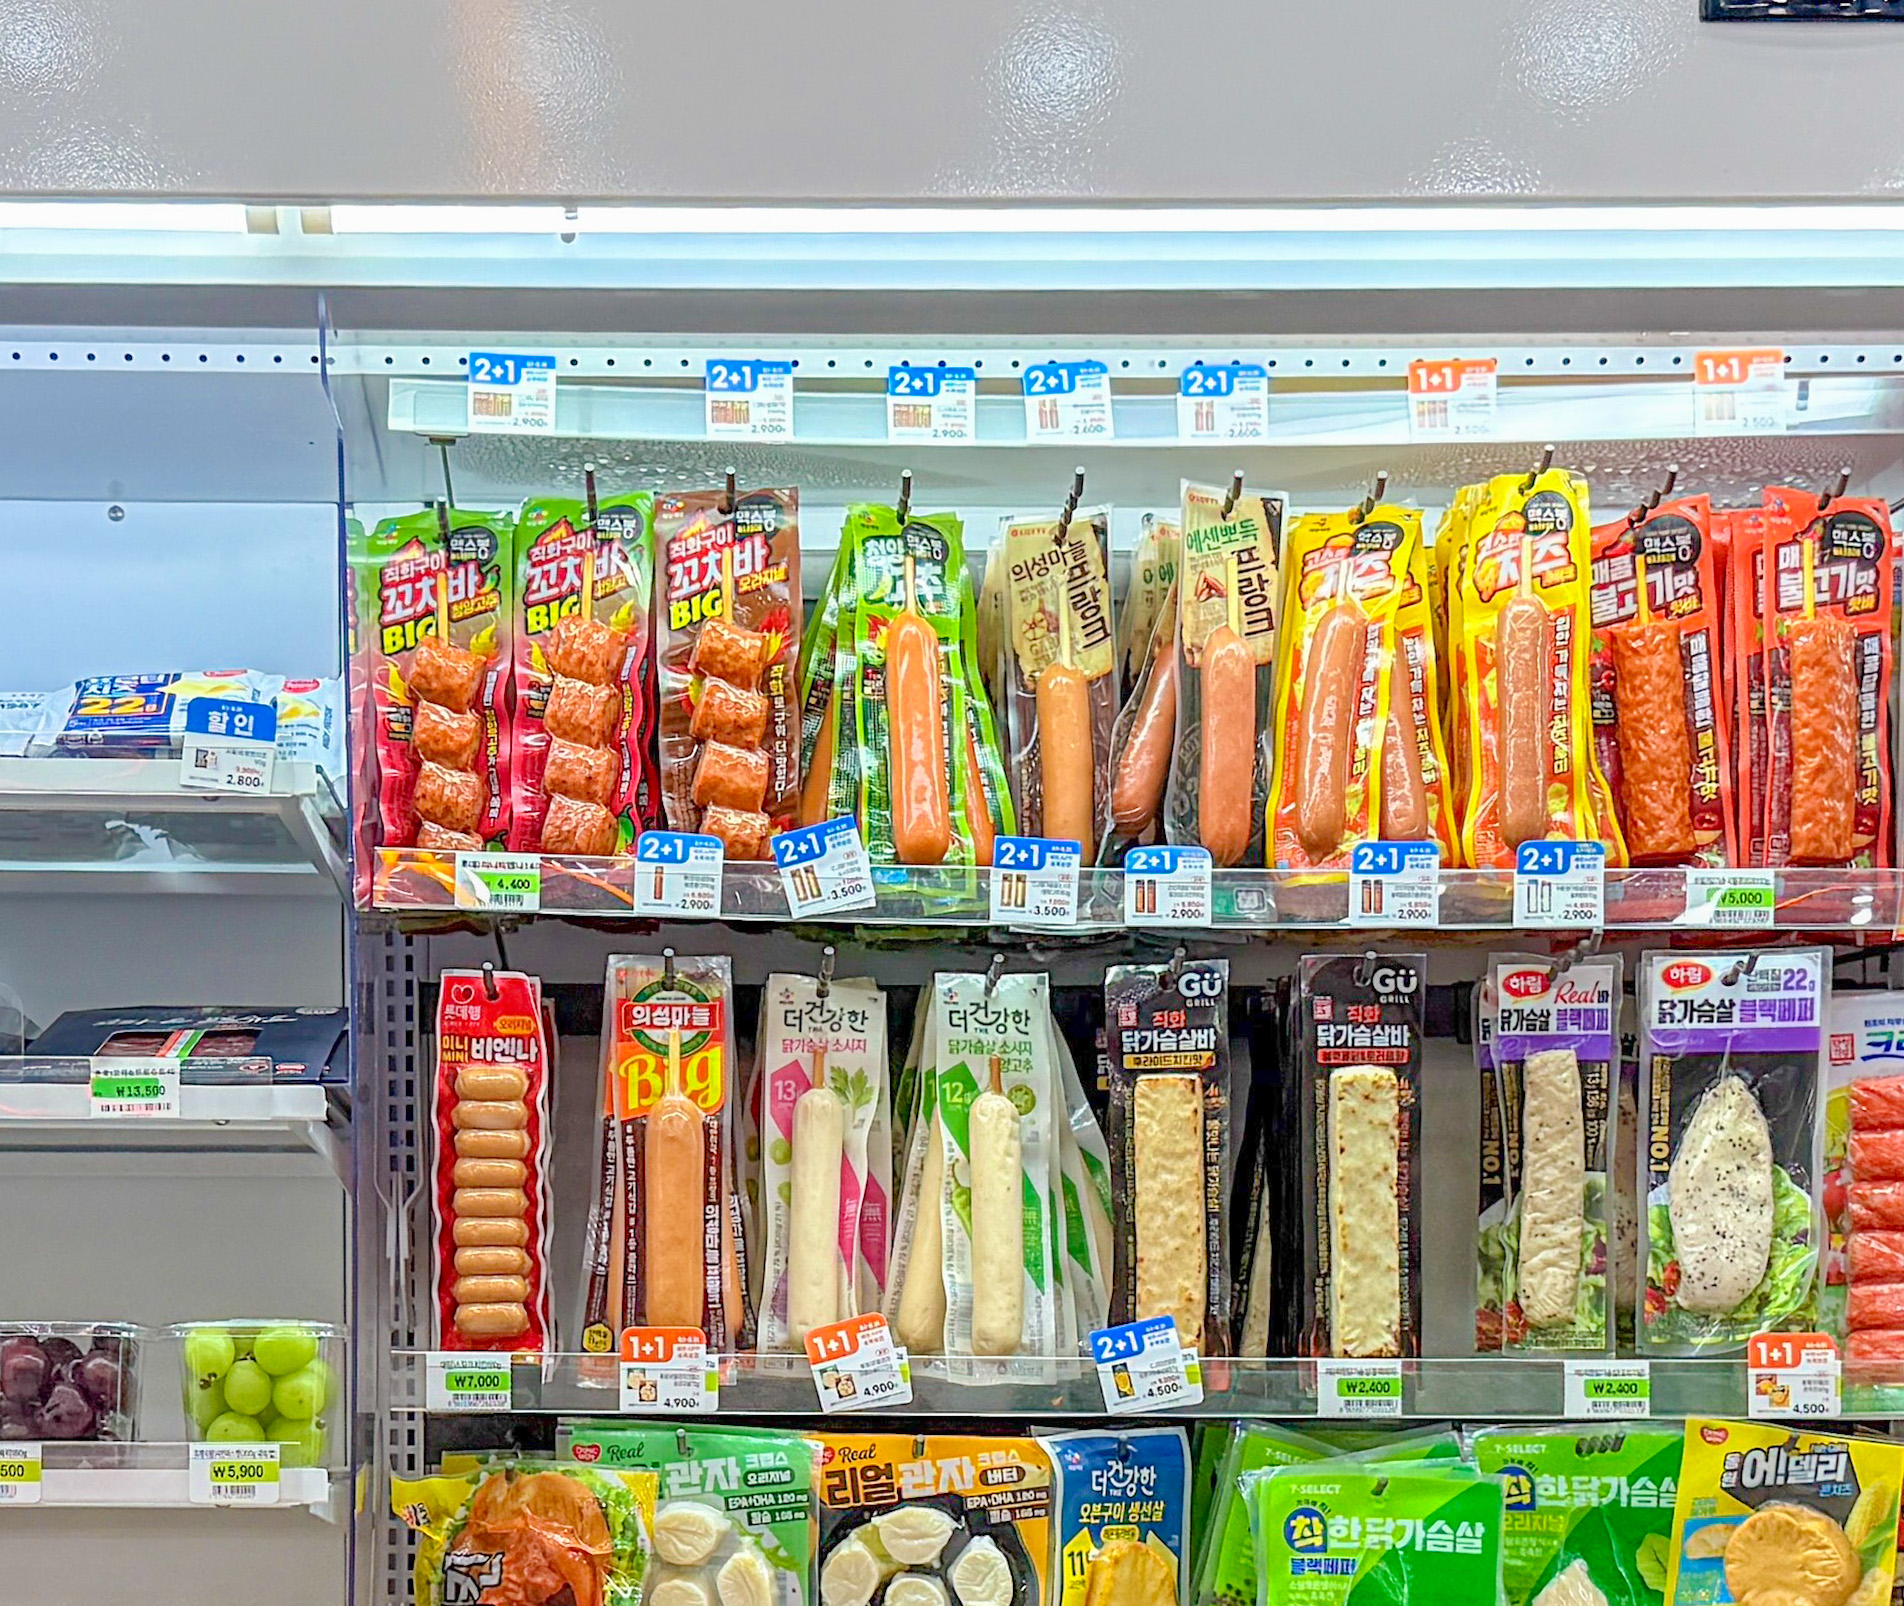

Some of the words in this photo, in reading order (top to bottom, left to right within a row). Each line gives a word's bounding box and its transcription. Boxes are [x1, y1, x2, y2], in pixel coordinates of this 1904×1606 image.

[1416, 367, 1454, 389] 1+1
[1703, 360, 1740, 380] 1+1
[1187, 371, 1228, 393] 2+1
[526, 593, 581, 633] BIG
[670, 589, 723, 629] BIG
[207, 711, 255, 737] 할인
[643, 838, 684, 861] 2+1
[779, 834, 822, 862] 2+1
[1000, 843, 1041, 866] 2+1
[1358, 848, 1399, 871] 2+1
[1523, 848, 1565, 871] 2+1
[1132, 851, 1171, 874] 2+1
[1509, 975, 1544, 995] 하림
[1668, 965, 1703, 985] 하림
[631, 1005, 711, 1028] 의성마늘
[1657, 999, 1736, 1026] 닭가슴살
[470, 1036, 539, 1064] 비엔나
[629, 1336, 665, 1359] 1+1
[811, 1329, 852, 1356] 1+1
[1097, 1332, 1143, 1361] 2+1
[1757, 1341, 1793, 1363] 1+1
[607, 1442, 644, 1461] Real
[838, 1443, 876, 1462] Real
[213, 1463, 266, 1480] ₩5,900
[826, 1461, 895, 1508] 리얼
